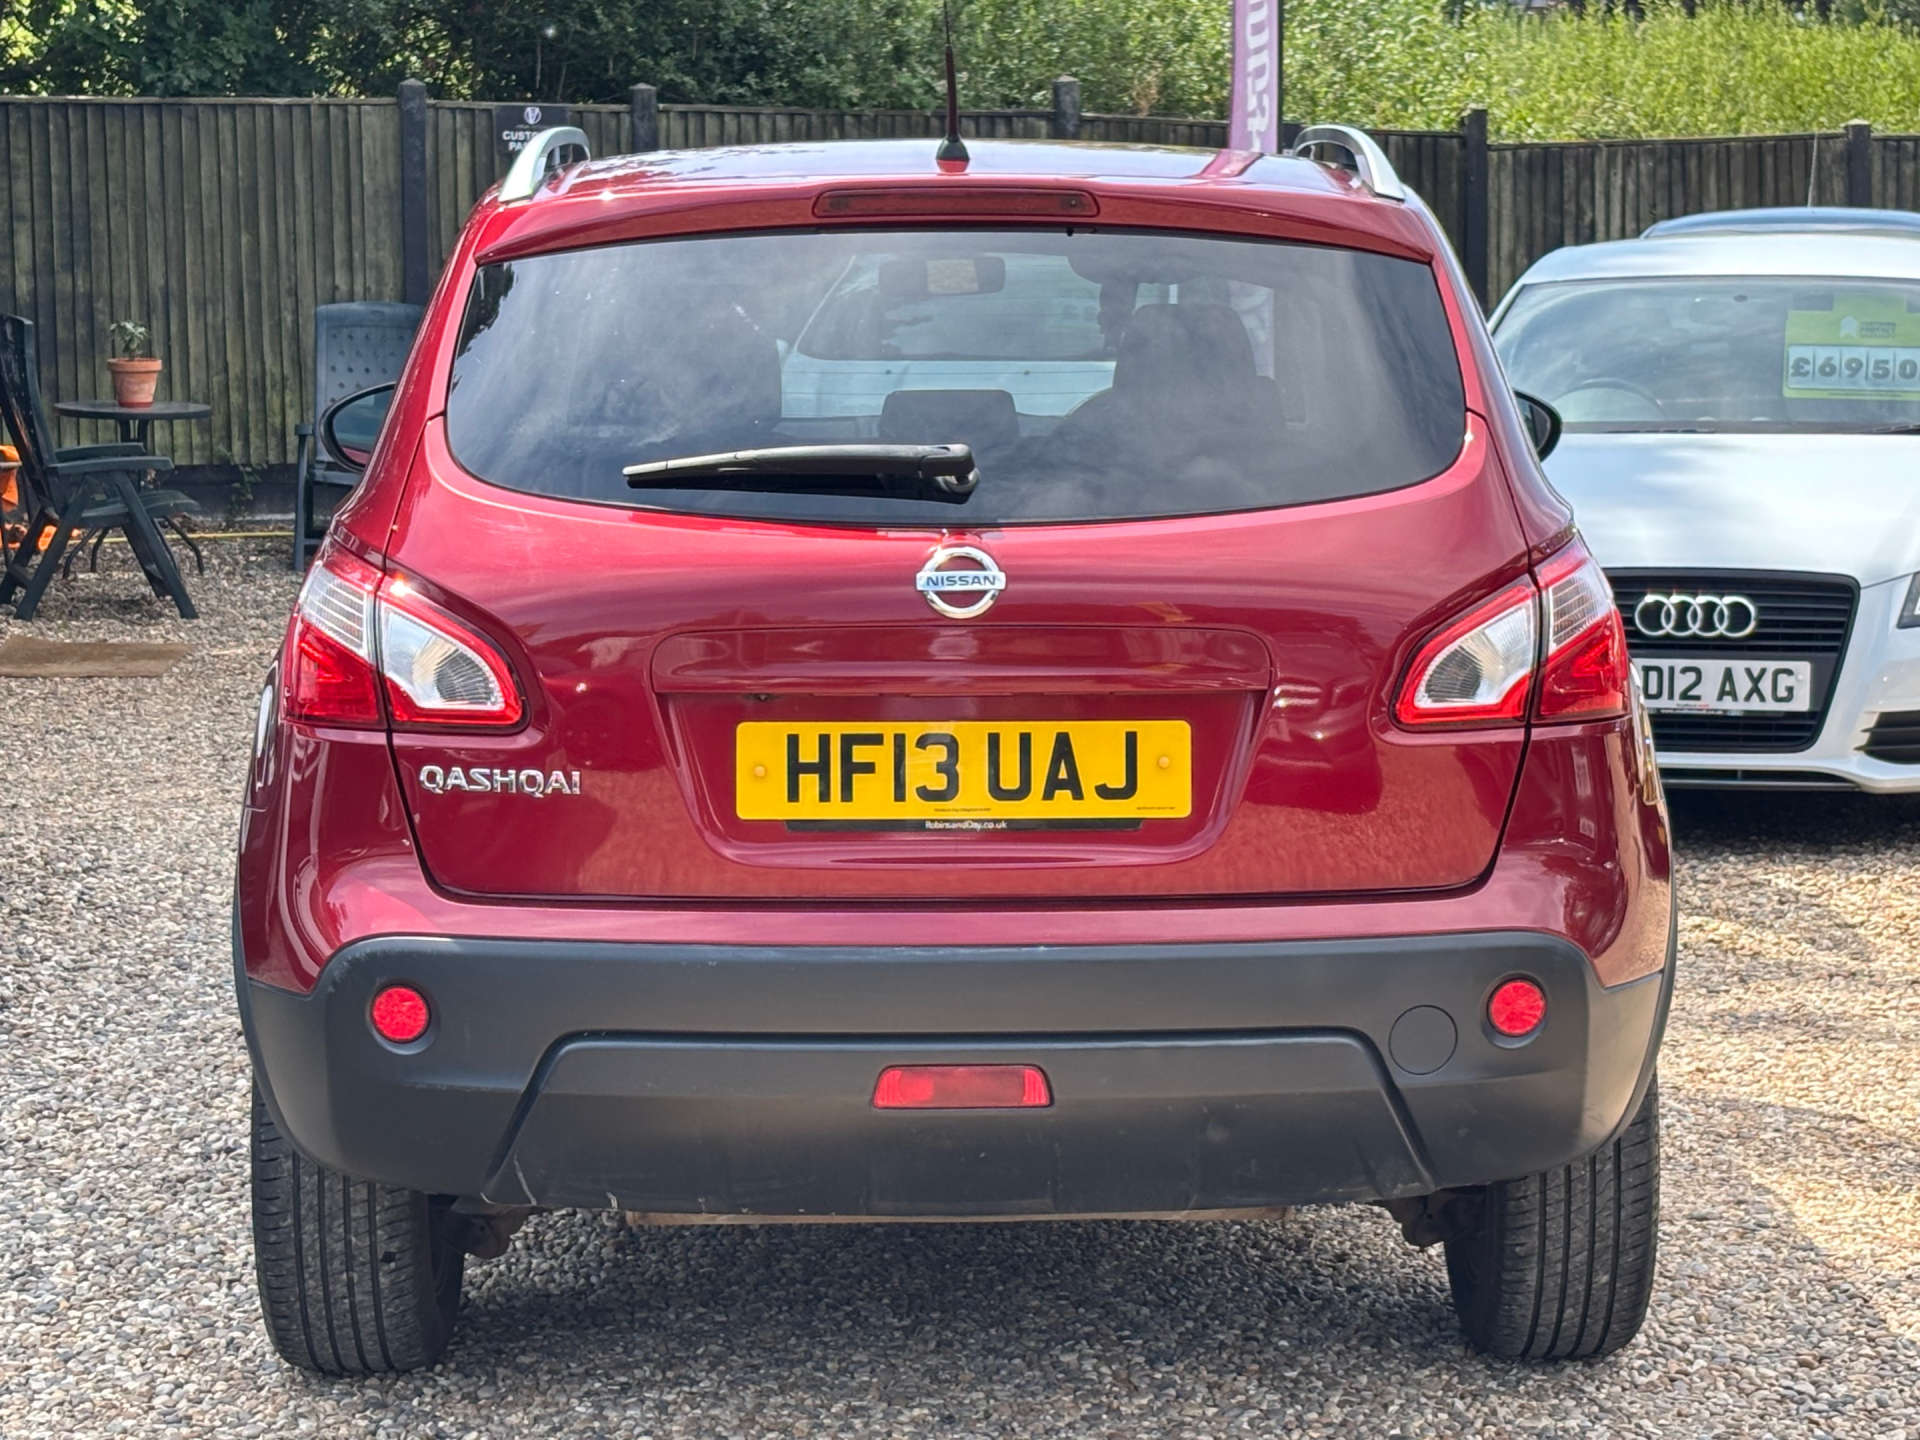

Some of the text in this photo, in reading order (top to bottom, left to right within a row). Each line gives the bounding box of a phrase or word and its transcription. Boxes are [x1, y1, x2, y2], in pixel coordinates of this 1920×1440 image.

[502, 131, 538, 140] CUST
[1790, 356, 1918, 380] £6950
[926, 575, 996, 587] NISSAN
[1641, 665, 1795, 703] D12 AXG
[786, 731, 1139, 803] HF13 UAJ
[419, 765, 581, 798] QASHQAI
